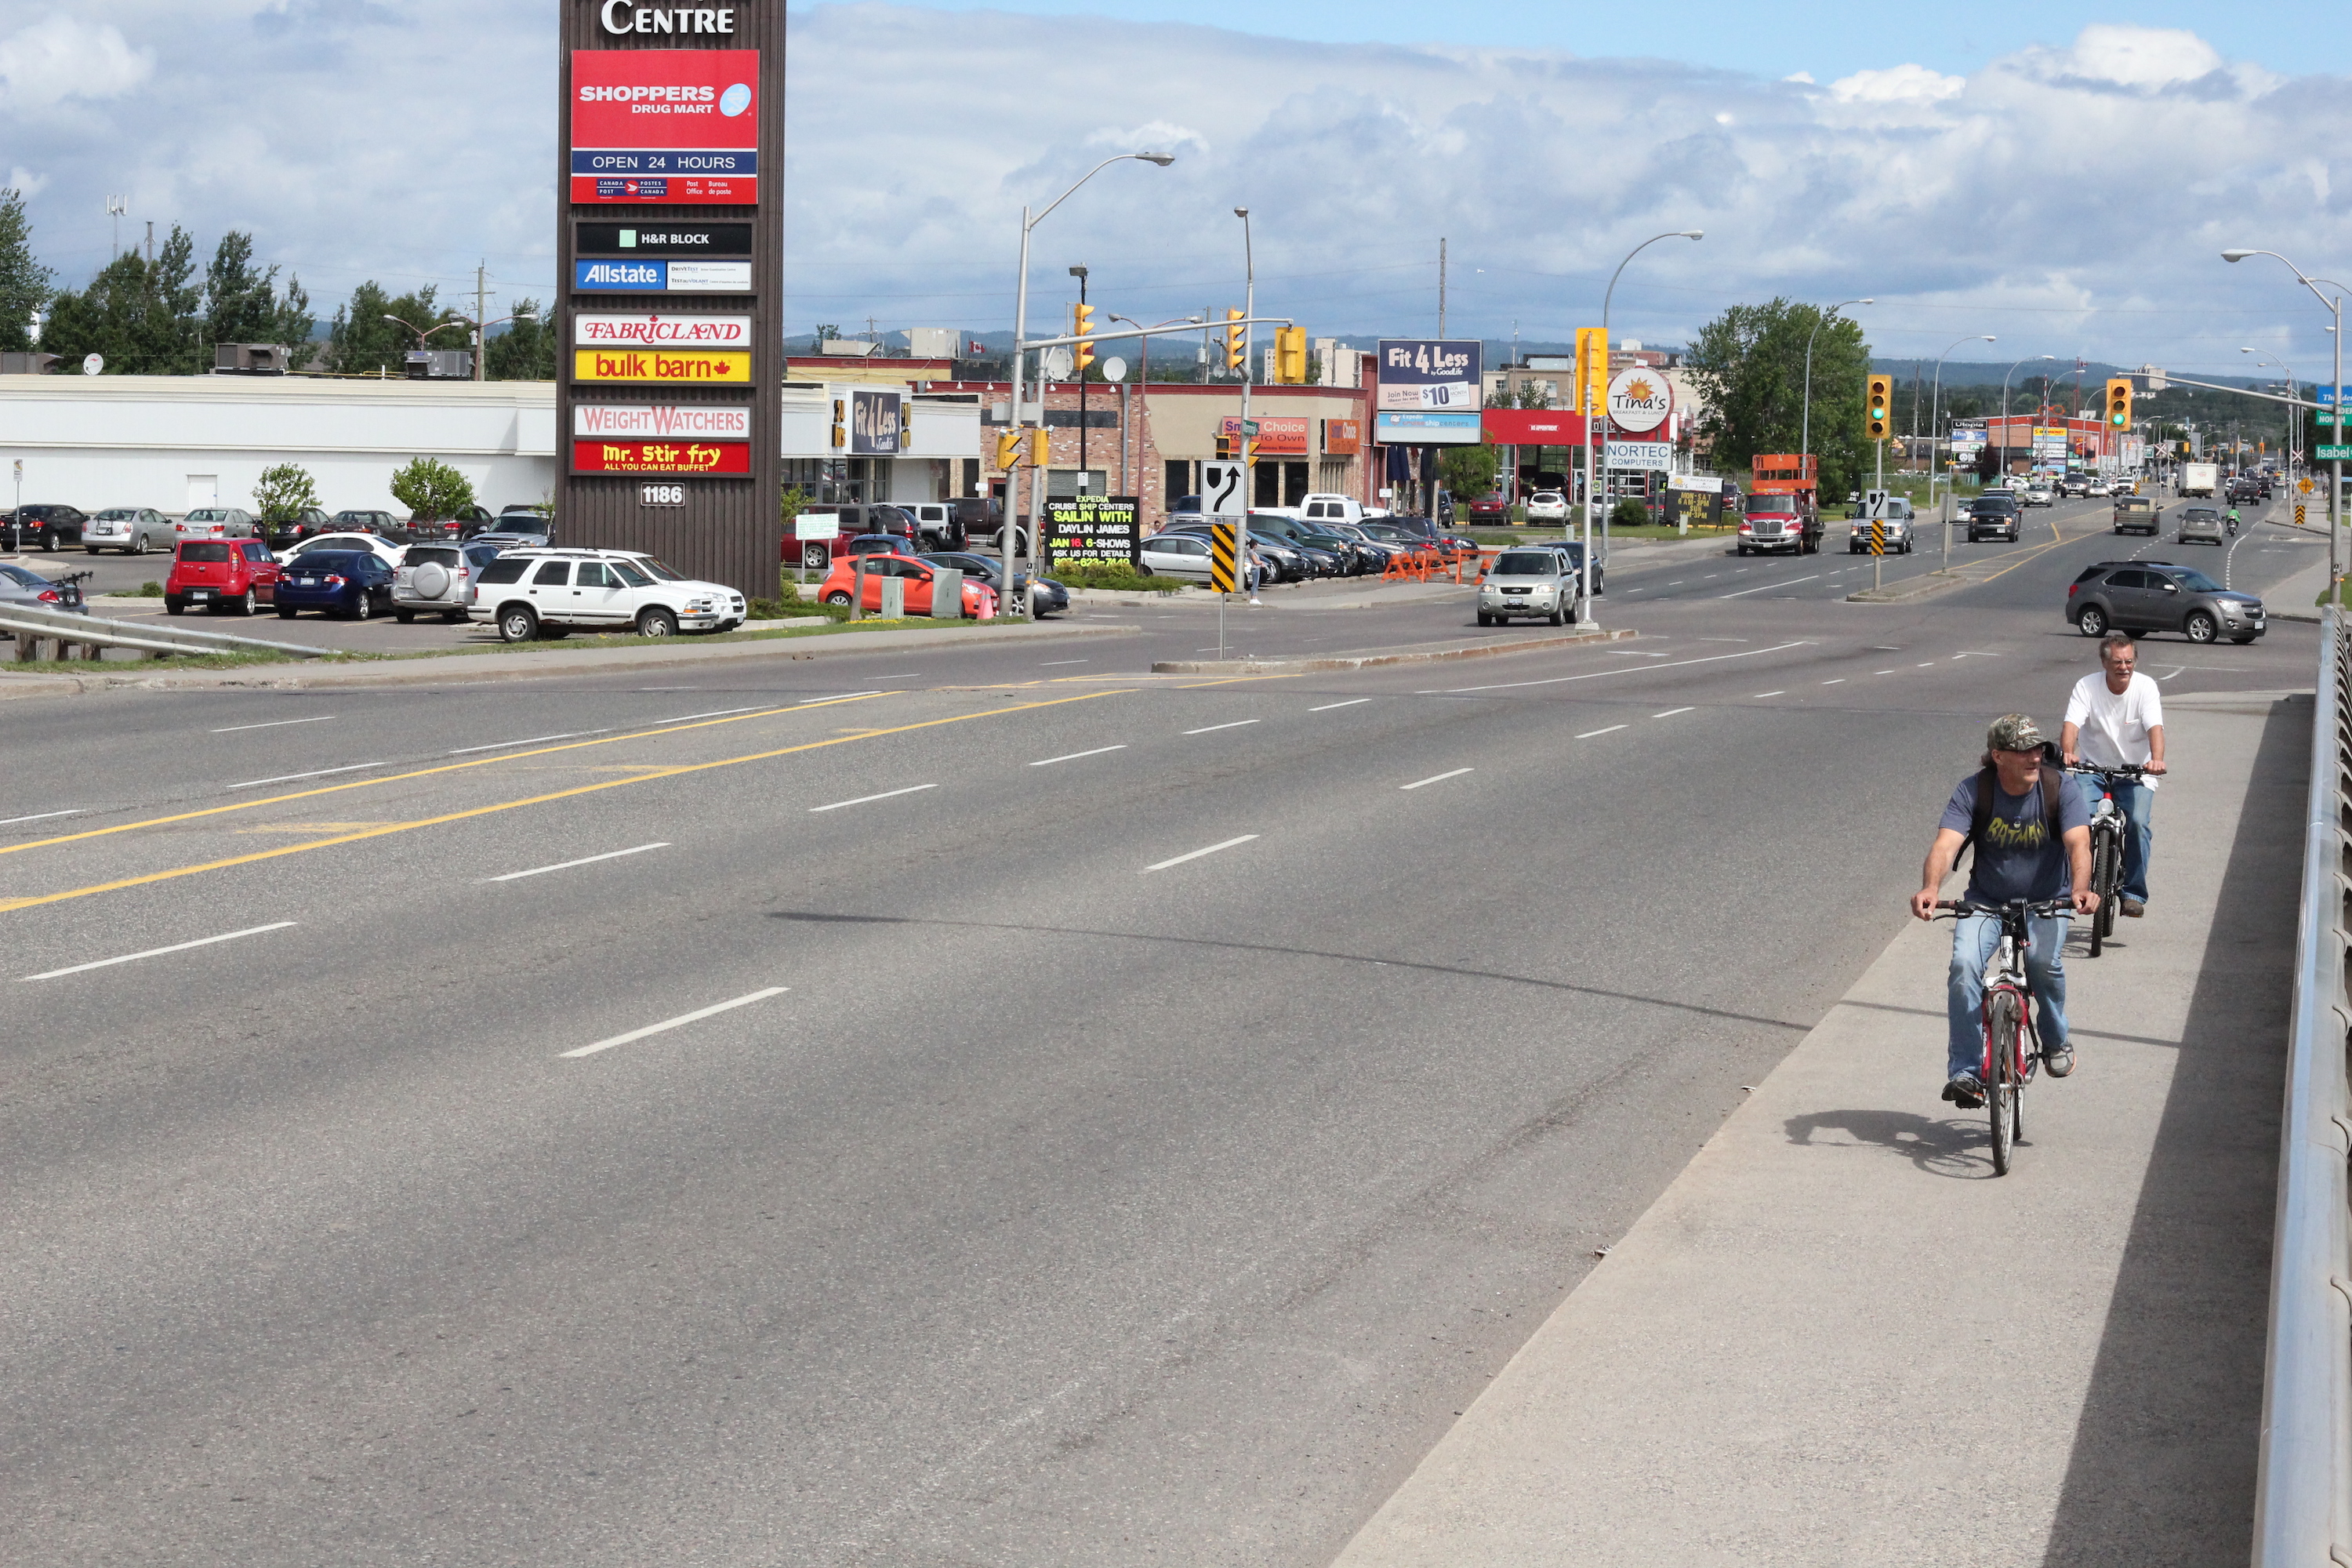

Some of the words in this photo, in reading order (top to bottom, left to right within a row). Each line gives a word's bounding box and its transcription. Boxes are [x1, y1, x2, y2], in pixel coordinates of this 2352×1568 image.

[579, 85, 715, 101] SHOPPERS
[632, 104, 671, 114] DRUG
[673, 104, 714, 114] MART
[593, 156, 638, 169] OPEN
[648, 156, 666, 169] 24
[677, 156, 735, 169] HOURS
[641, 234, 667, 245] H&R
[670, 234, 710, 245] BLOCK
[584, 265, 658, 283] Allstate
[585, 316, 741, 343] FABRICLAND
[596, 354, 647, 376] bulk
[655, 354, 711, 377] barn
[1388, 347, 1411, 368] Fit
[1415, 344, 1429, 374] 4
[1434, 346, 1469, 367] Less
[1436, 367, 1463, 376] GoodLife
[1423, 386, 1449, 406] $10
[1613, 394, 1666, 410] Tina's
[855, 400, 867, 437] Fit
[867, 395, 875, 448] 4
[877, 397, 896, 436] Less
[1226, 421, 1260, 431] Smt
[1264, 421, 1305, 432] Choice
[1343, 422, 1357, 439] Choice
[642, 444, 680, 463] Stir
[1608, 445, 1668, 457] NORTEC
[2317, 446, 2349, 458] Isabel
[643, 486, 683, 503] 1186
[1053, 511, 1094, 522] SAILIN
[1099, 511, 1132, 522] WITH
[1058, 524, 1094, 533] DAYLIN
[1096, 524, 1130, 534] JAMES
[1049, 538, 1069, 547] JAN
[1985, 817, 2047, 849] BATMAN
